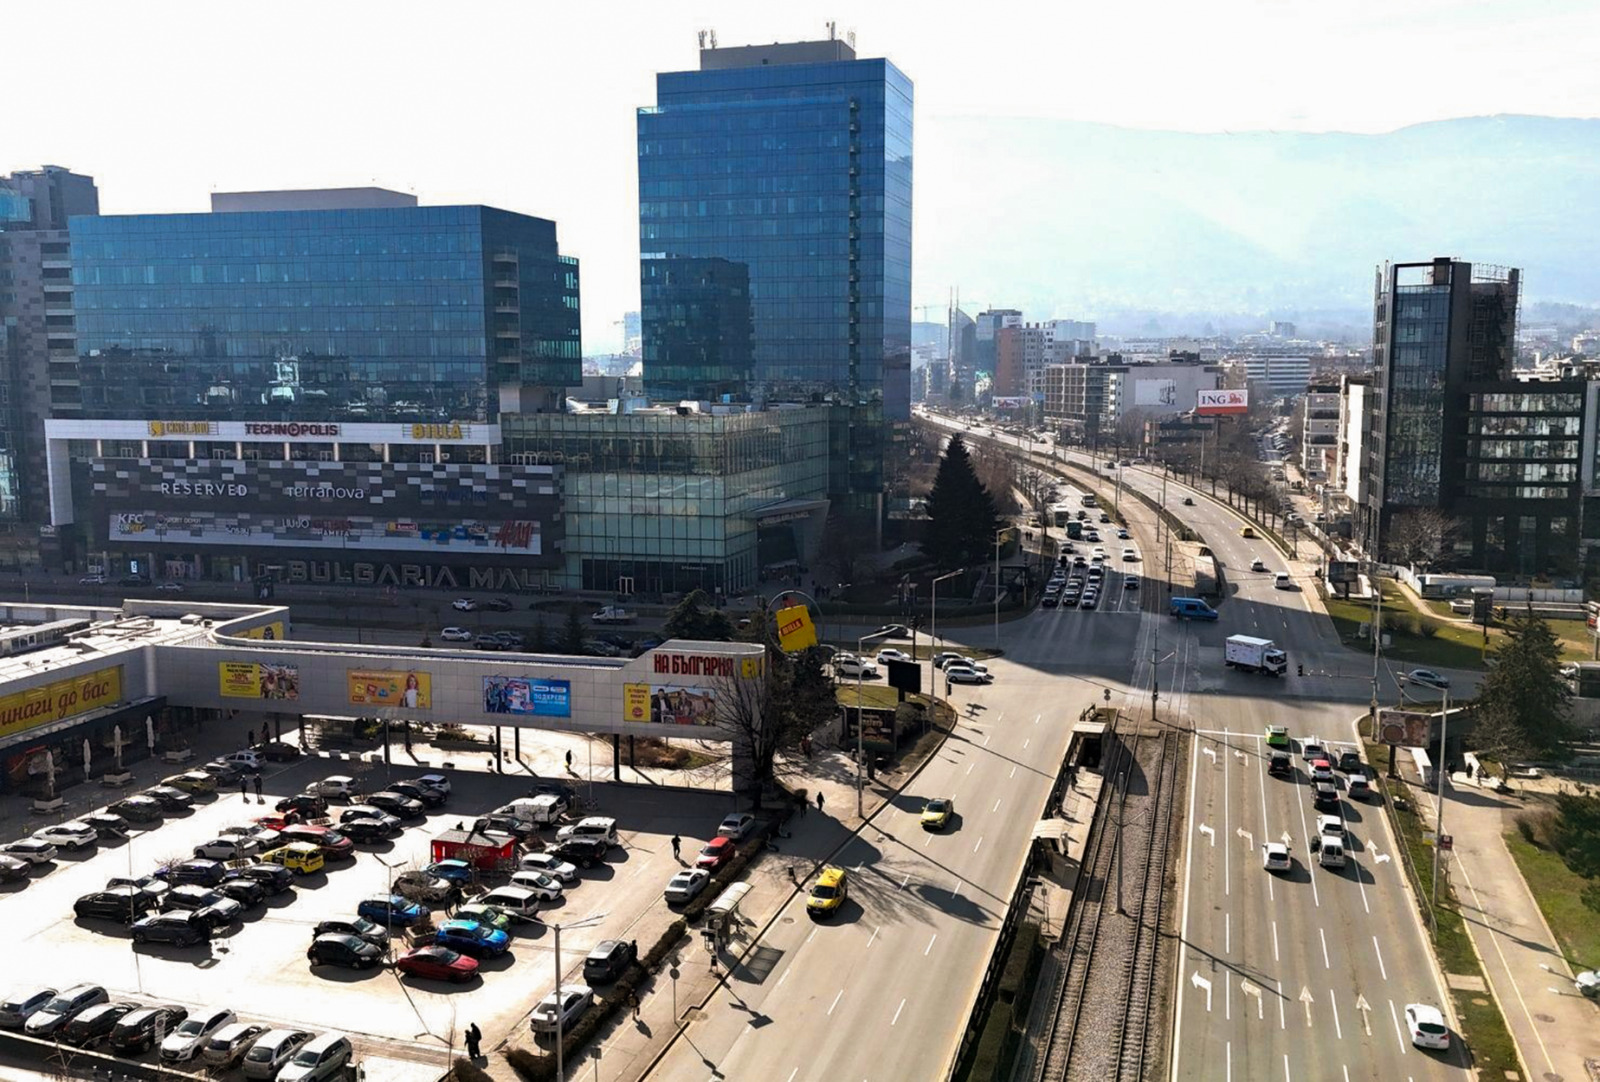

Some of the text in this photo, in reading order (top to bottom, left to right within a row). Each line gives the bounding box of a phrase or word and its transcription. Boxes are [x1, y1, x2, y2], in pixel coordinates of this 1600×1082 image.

[1202, 395, 1226, 405] ING
[412, 424, 463, 439] BILLA
[160, 482, 248, 497] RESERVED
[118, 513, 143, 524] KFC
[288, 560, 562, 591] BULGARIA MALL
[782, 620, 801, 635] BILLA
[653, 653, 669, 673] НА
[83, 681, 110, 702] вас
